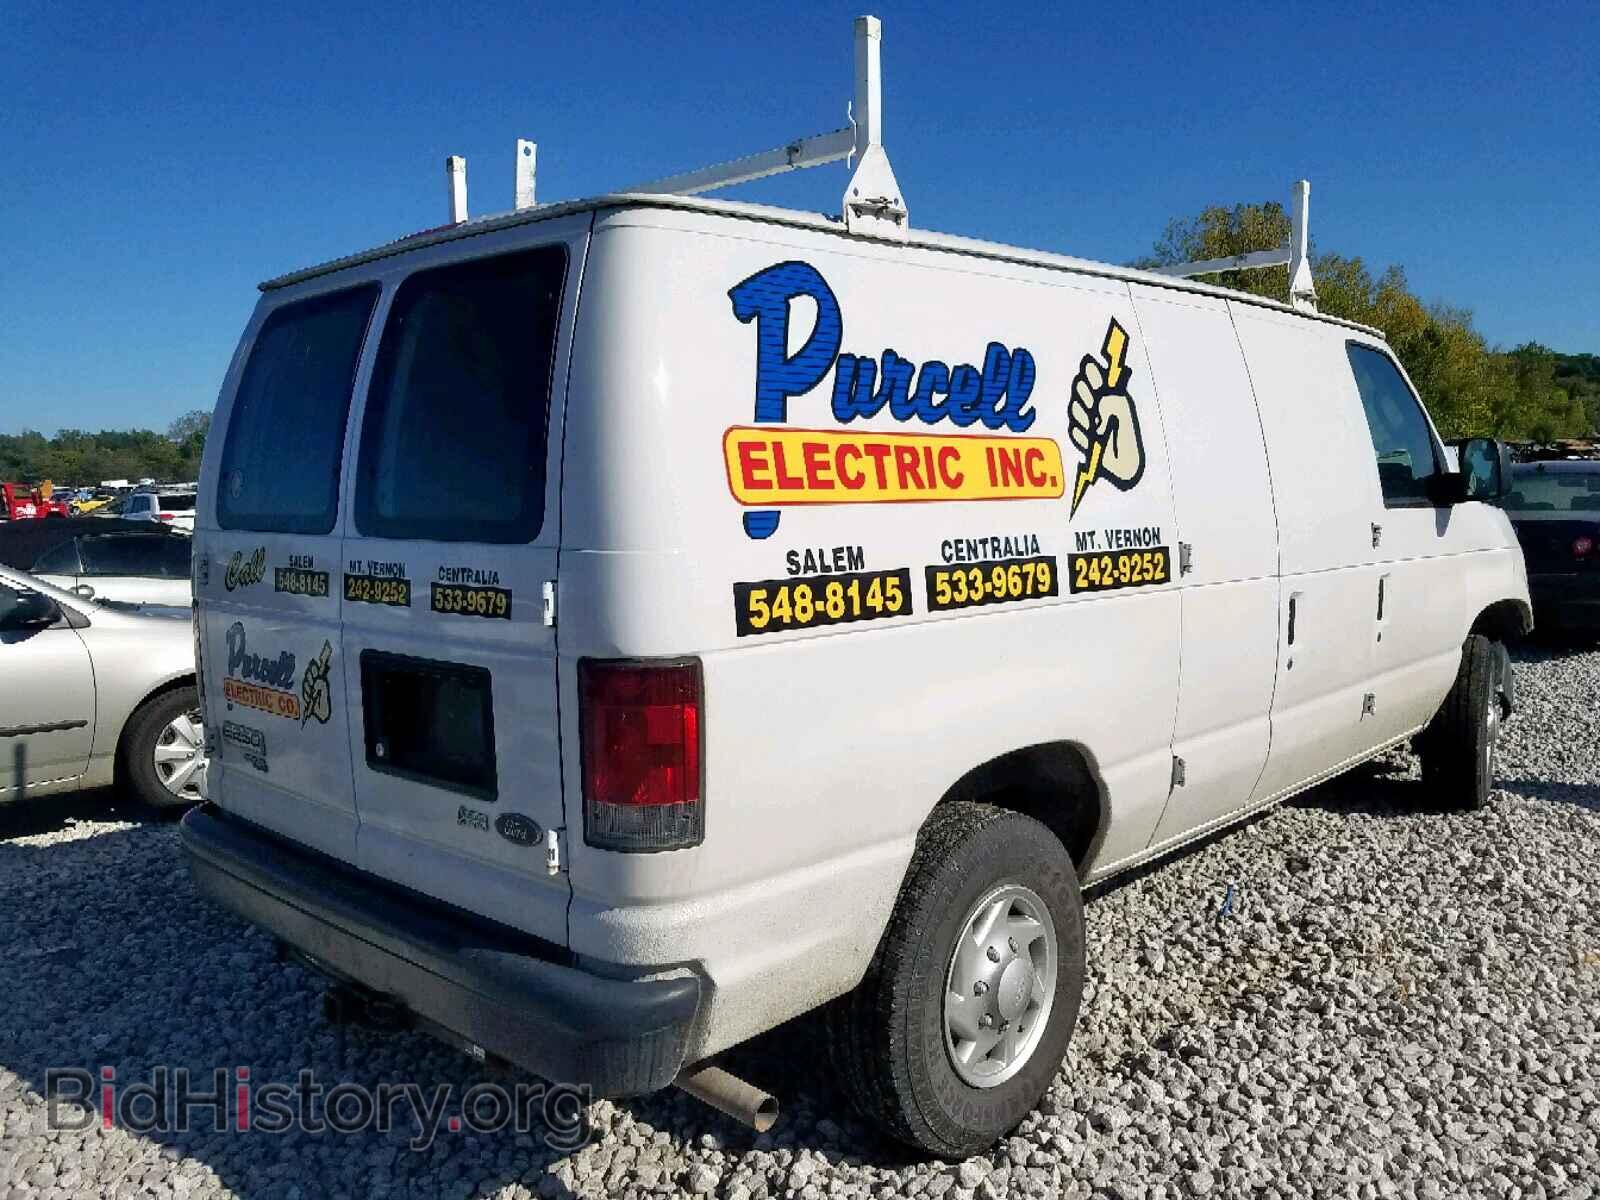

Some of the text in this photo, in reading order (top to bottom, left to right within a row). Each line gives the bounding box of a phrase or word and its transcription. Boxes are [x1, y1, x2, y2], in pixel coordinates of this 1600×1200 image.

[727, 260, 1037, 539] Purcell
[737, 441, 1058, 490] ELECTRIC INC.
[941, 534, 1041, 564] CENTRALIA
[1075, 527, 1161, 553] MT. VERNON
[225, 546, 266, 592] Call
[289, 555, 314, 569] SALEM
[367, 560, 406, 578] VERNON
[438, 566, 500, 585] CENTRALIA
[786, 546, 865, 576] SALEM
[1075, 554, 1165, 588] 242-9252
[347, 577, 407, 604] 242-9252
[935, 564, 1050, 606] 533-9679
[434, 587, 507, 615] 533-9679
[748, 576, 904, 629] 548-8145
